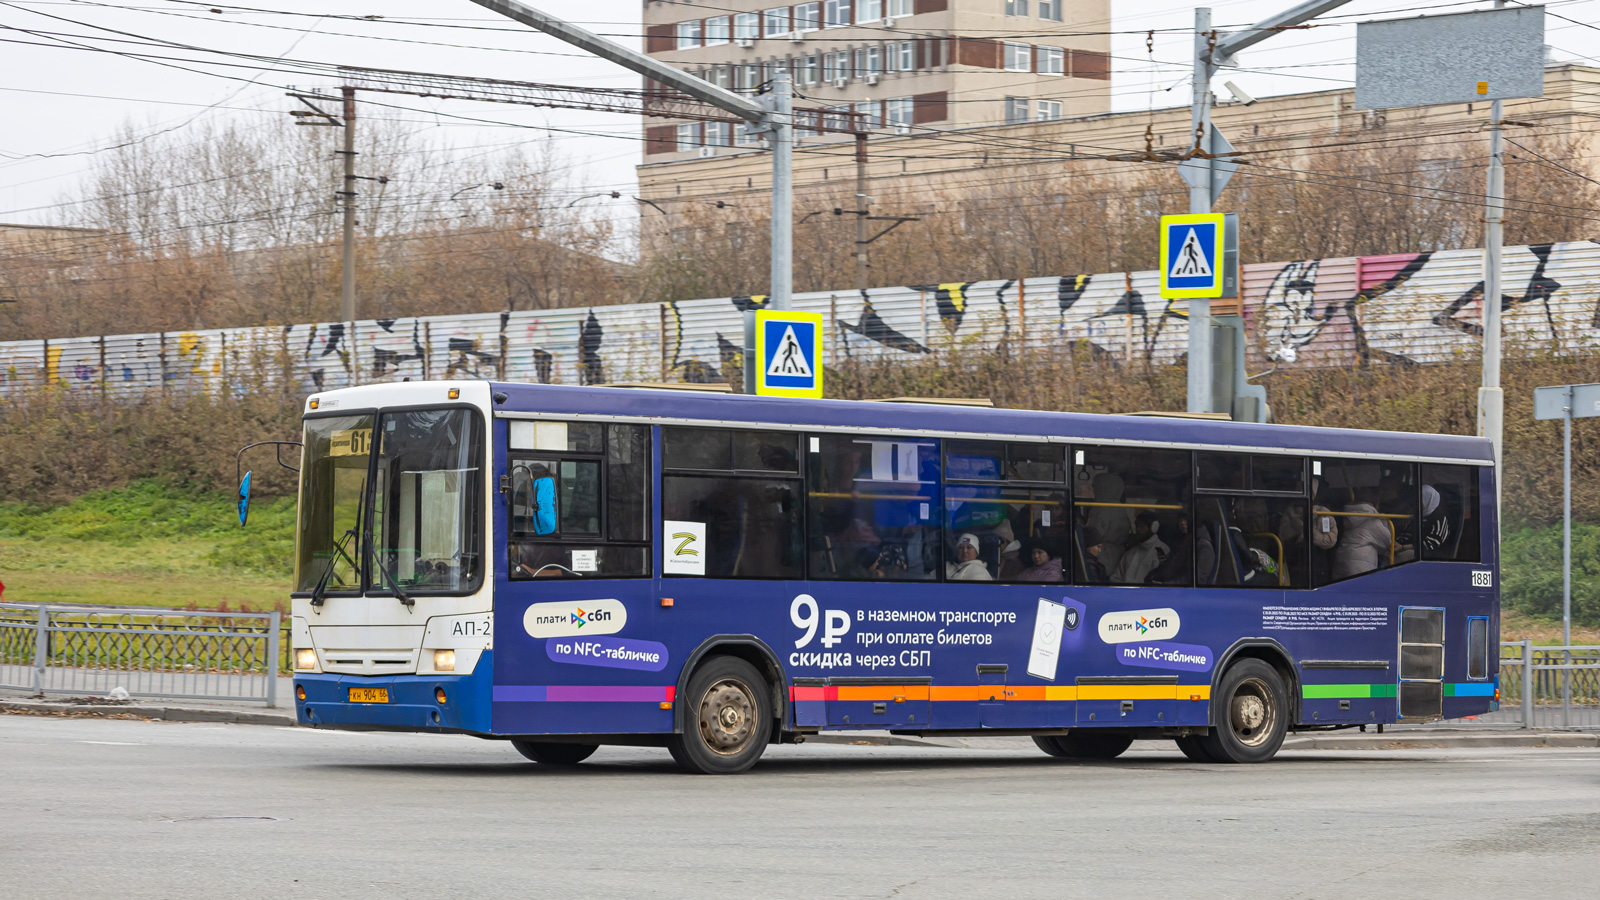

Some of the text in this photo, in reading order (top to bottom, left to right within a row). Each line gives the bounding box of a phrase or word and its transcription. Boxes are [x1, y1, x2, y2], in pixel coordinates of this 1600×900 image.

[672, 532, 698, 556] Z
[1473, 573, 1491, 585] 1881
[537, 609, 611, 625] плати сбп
[857, 610, 1016, 626] в наземном транспорте
[1108, 617, 1168, 632] плати сбп
[452, 621, 491, 636] АП-2
[857, 629, 992, 647] при оплате билетов
[555, 641, 660, 664] по NFC-табличке
[790, 651, 930, 670] скидка через СБП
[1124, 646, 1207, 664] по NFC-табличке
[364, 689, 376, 701] 904
[379, 689, 386, 698] 66
